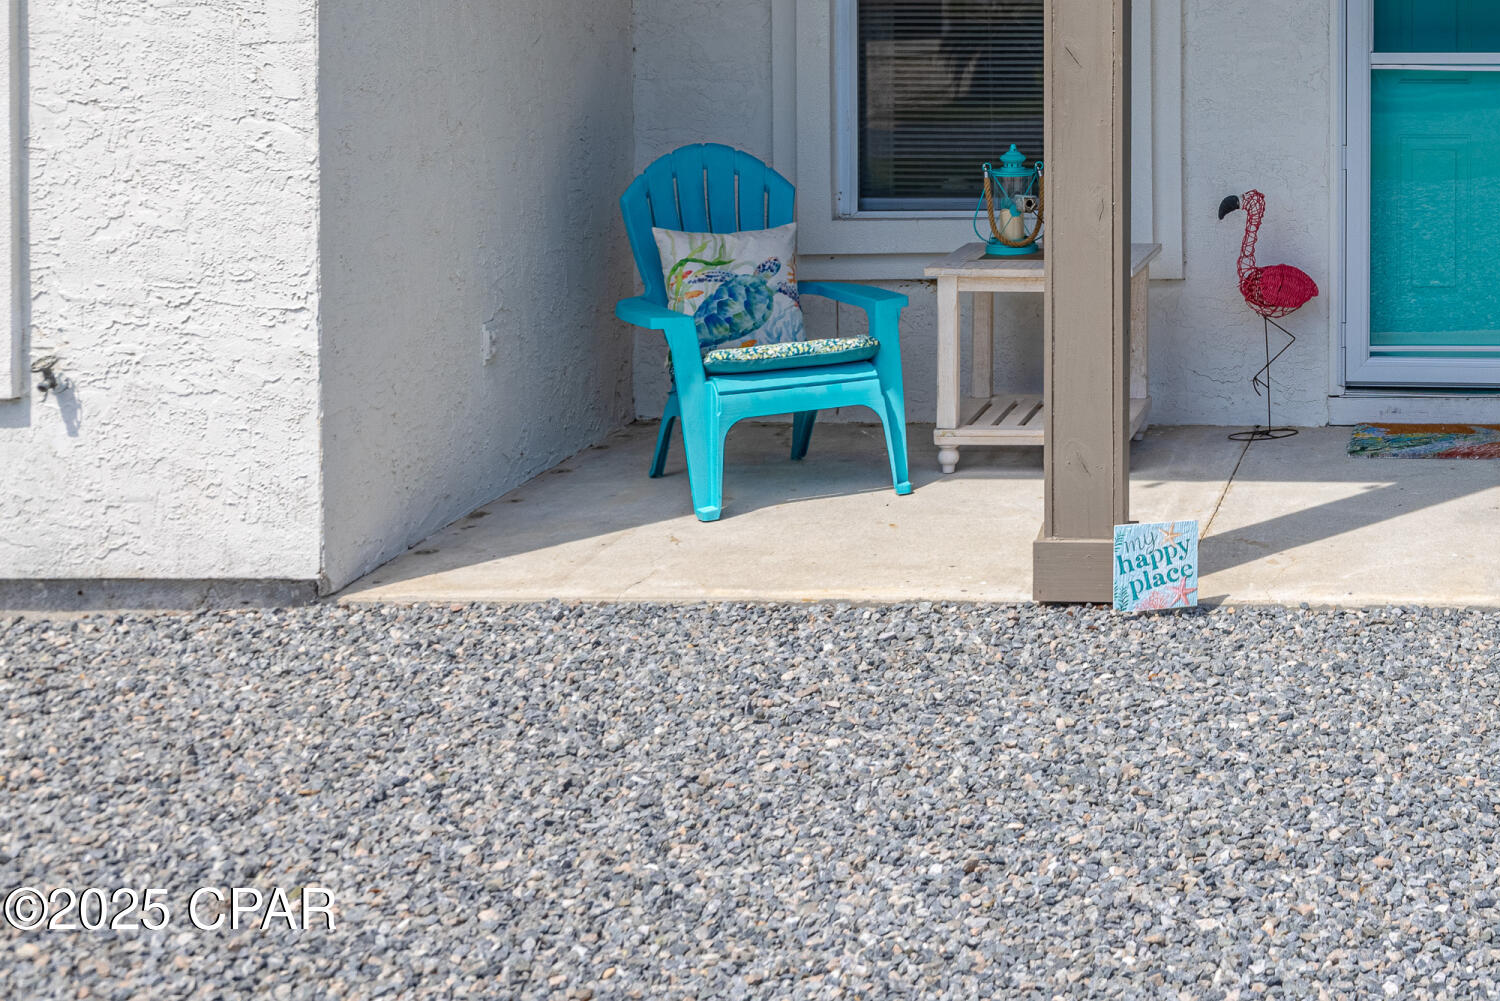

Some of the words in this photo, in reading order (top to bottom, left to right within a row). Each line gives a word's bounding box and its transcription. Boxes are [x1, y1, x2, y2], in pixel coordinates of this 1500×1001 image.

[1116, 538, 1190, 575] happy
[1124, 532, 1158, 555] my
[1129, 563, 1194, 601] place
